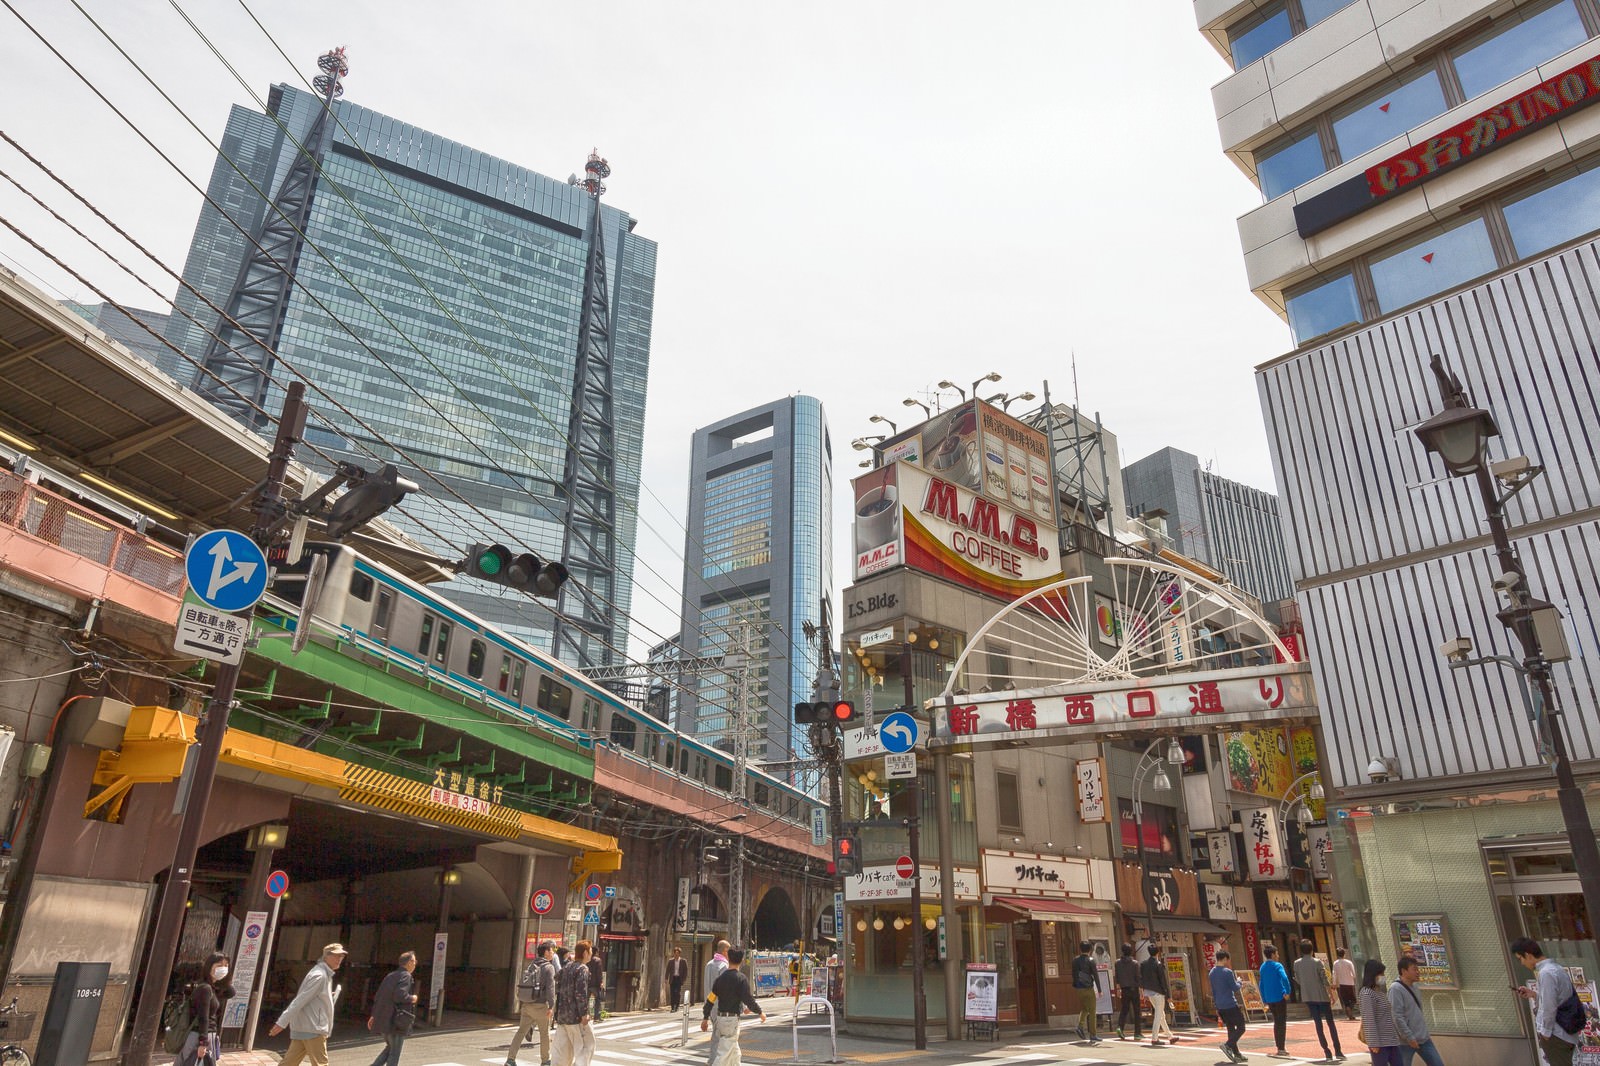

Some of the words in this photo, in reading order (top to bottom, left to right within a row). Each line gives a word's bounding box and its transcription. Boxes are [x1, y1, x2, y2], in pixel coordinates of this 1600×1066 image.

[952, 531, 1023, 577] COFFEE
[866, 559, 889, 574] COFFEE
[185, 608, 242, 634] 自転車を除く
[183, 627, 239, 648] 一方通行
[949, 676, 1285, 736] 新橋西口通り
[1082, 769, 1096, 802] ツバキ
[1085, 803, 1098, 812] cafe
[1250, 811, 1275, 876] 炭火焼肉
[1417, 922, 1441, 934] 新台
[76, 989, 102, 998] 108-54
